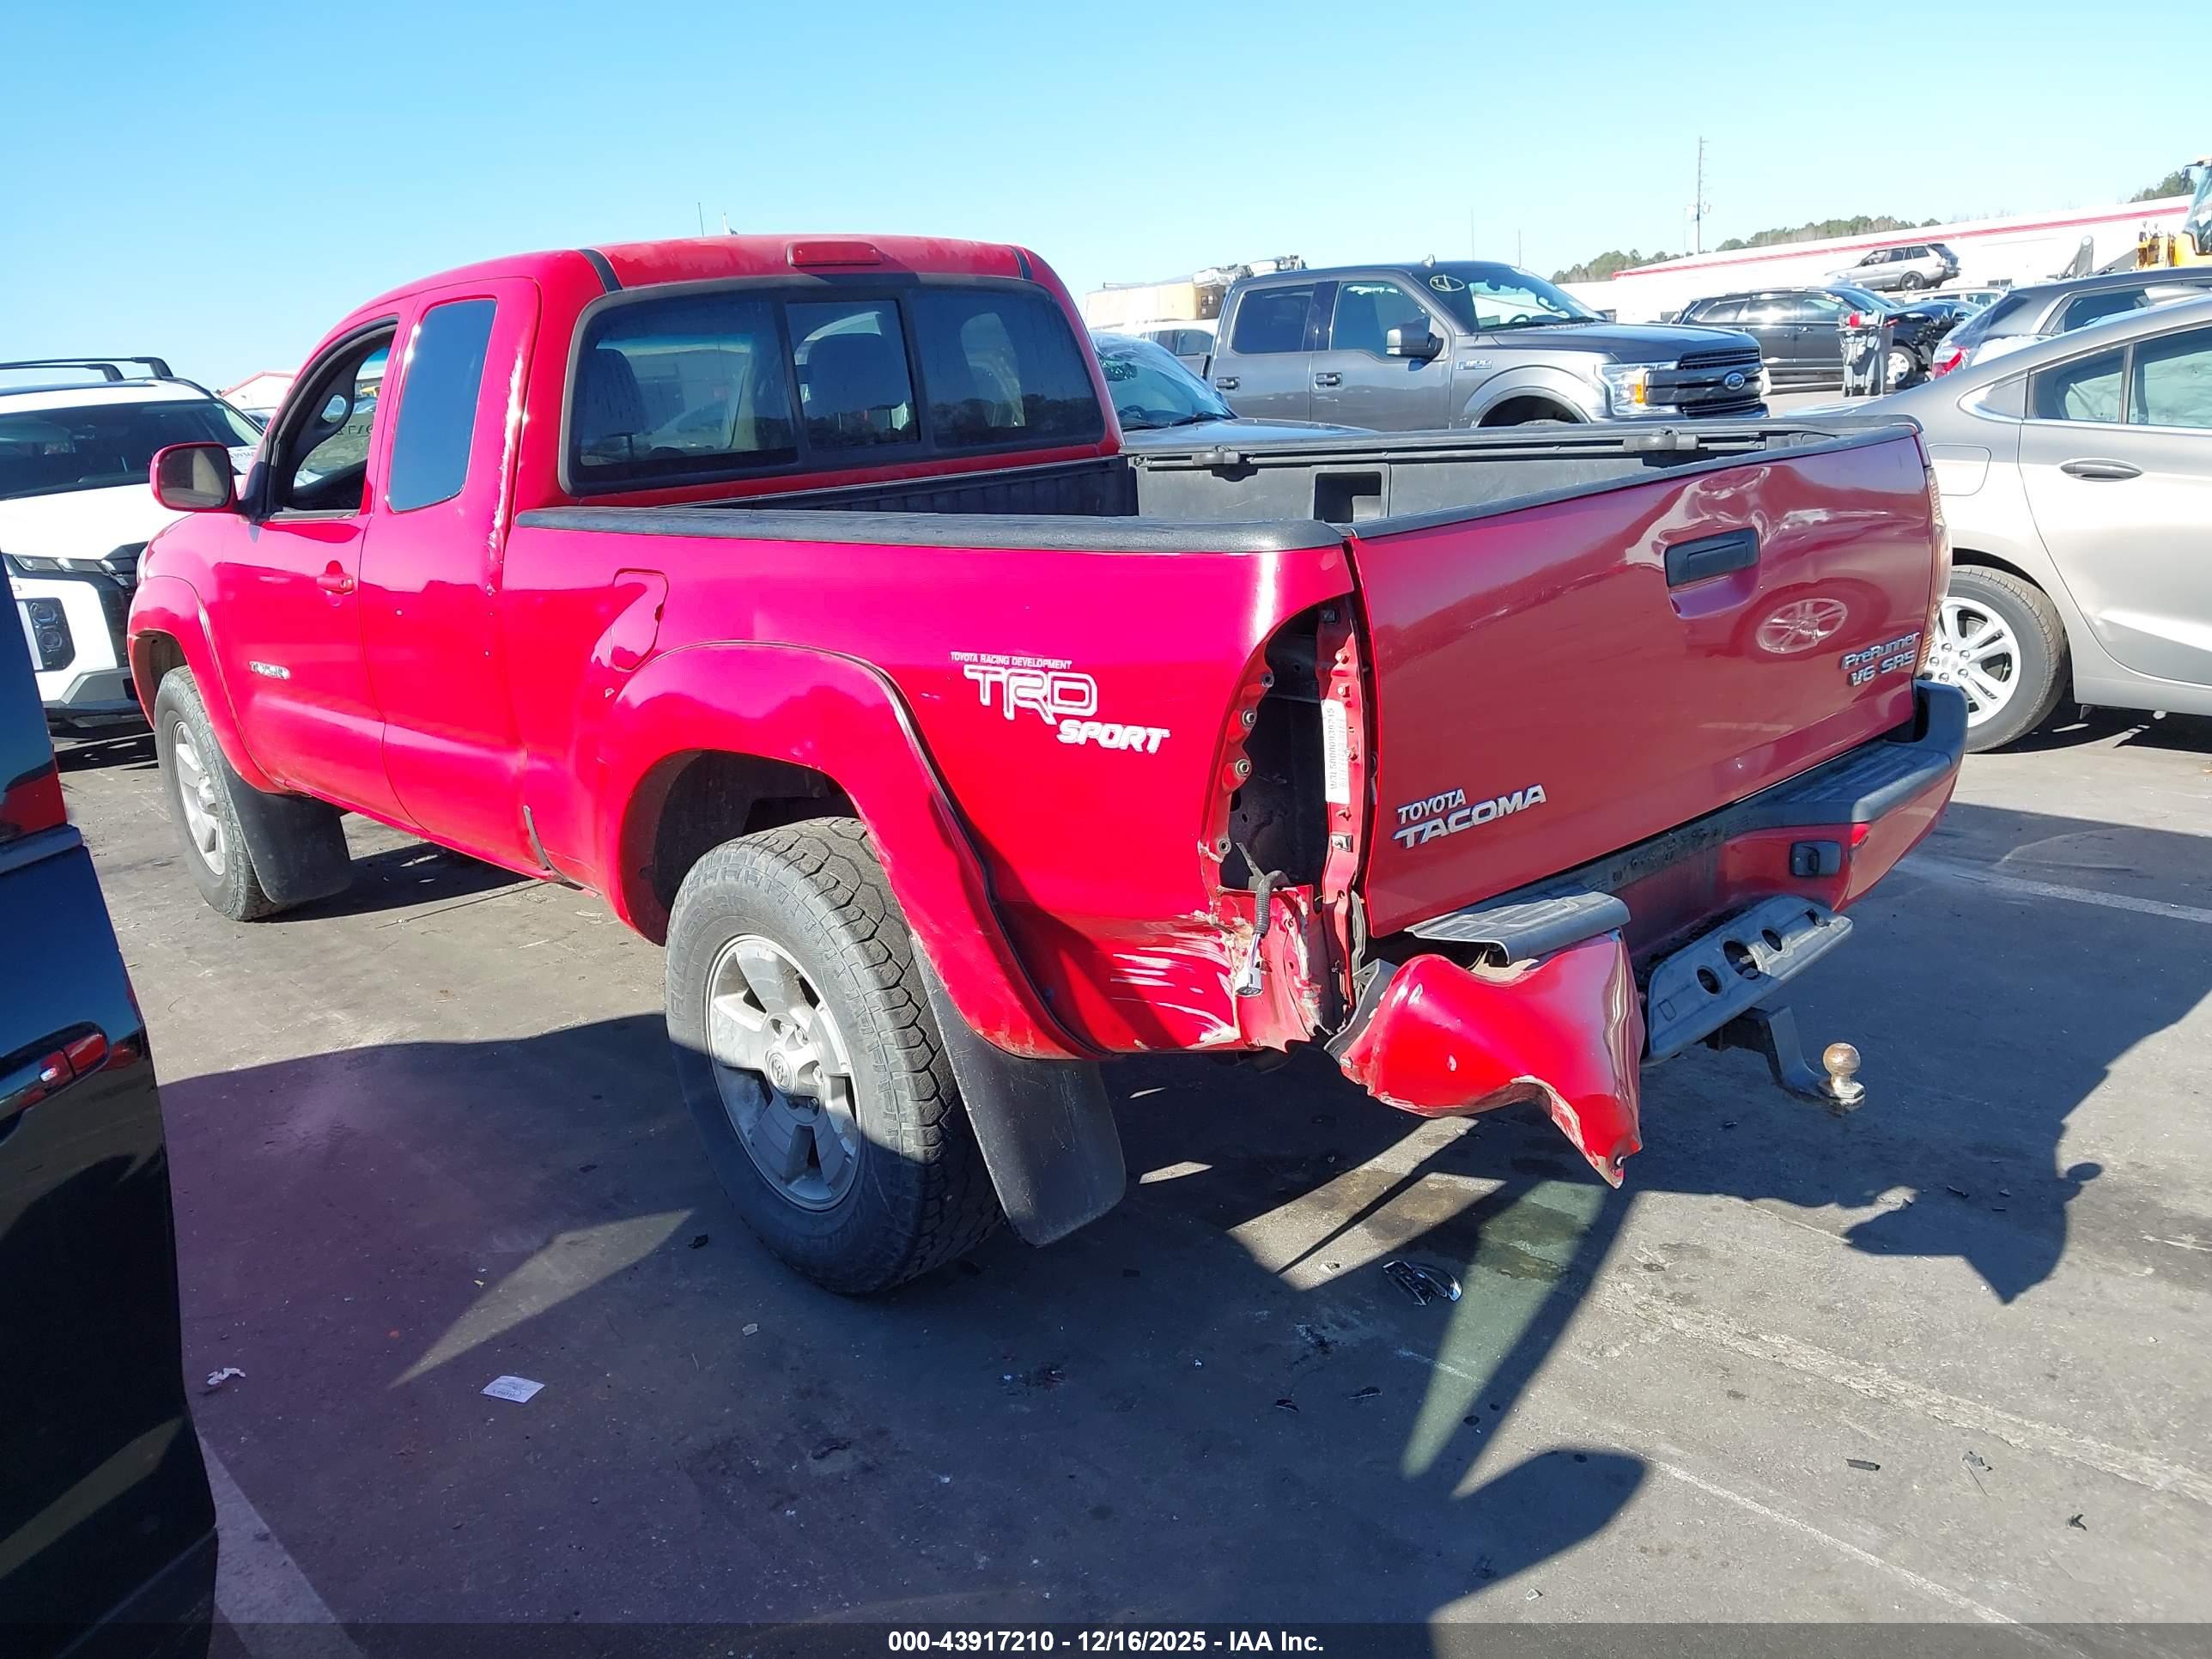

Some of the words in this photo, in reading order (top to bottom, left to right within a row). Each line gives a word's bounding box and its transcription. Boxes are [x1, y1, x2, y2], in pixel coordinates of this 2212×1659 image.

[951, 651, 978, 663] TOYOTA
[980, 653, 1009, 665] RACING
[1012, 657, 1073, 670] DEVELOPMENT
[1841, 632, 1920, 670] PreRunner
[1849, 665, 1875, 686] V6
[1881, 650, 1916, 674] SR5
[963, 665, 1097, 725] TRD
[1056, 719, 1170, 754] SPORT
[1393, 784, 1547, 849] TACOMA
[1397, 788, 1467, 824] TOYOTA
